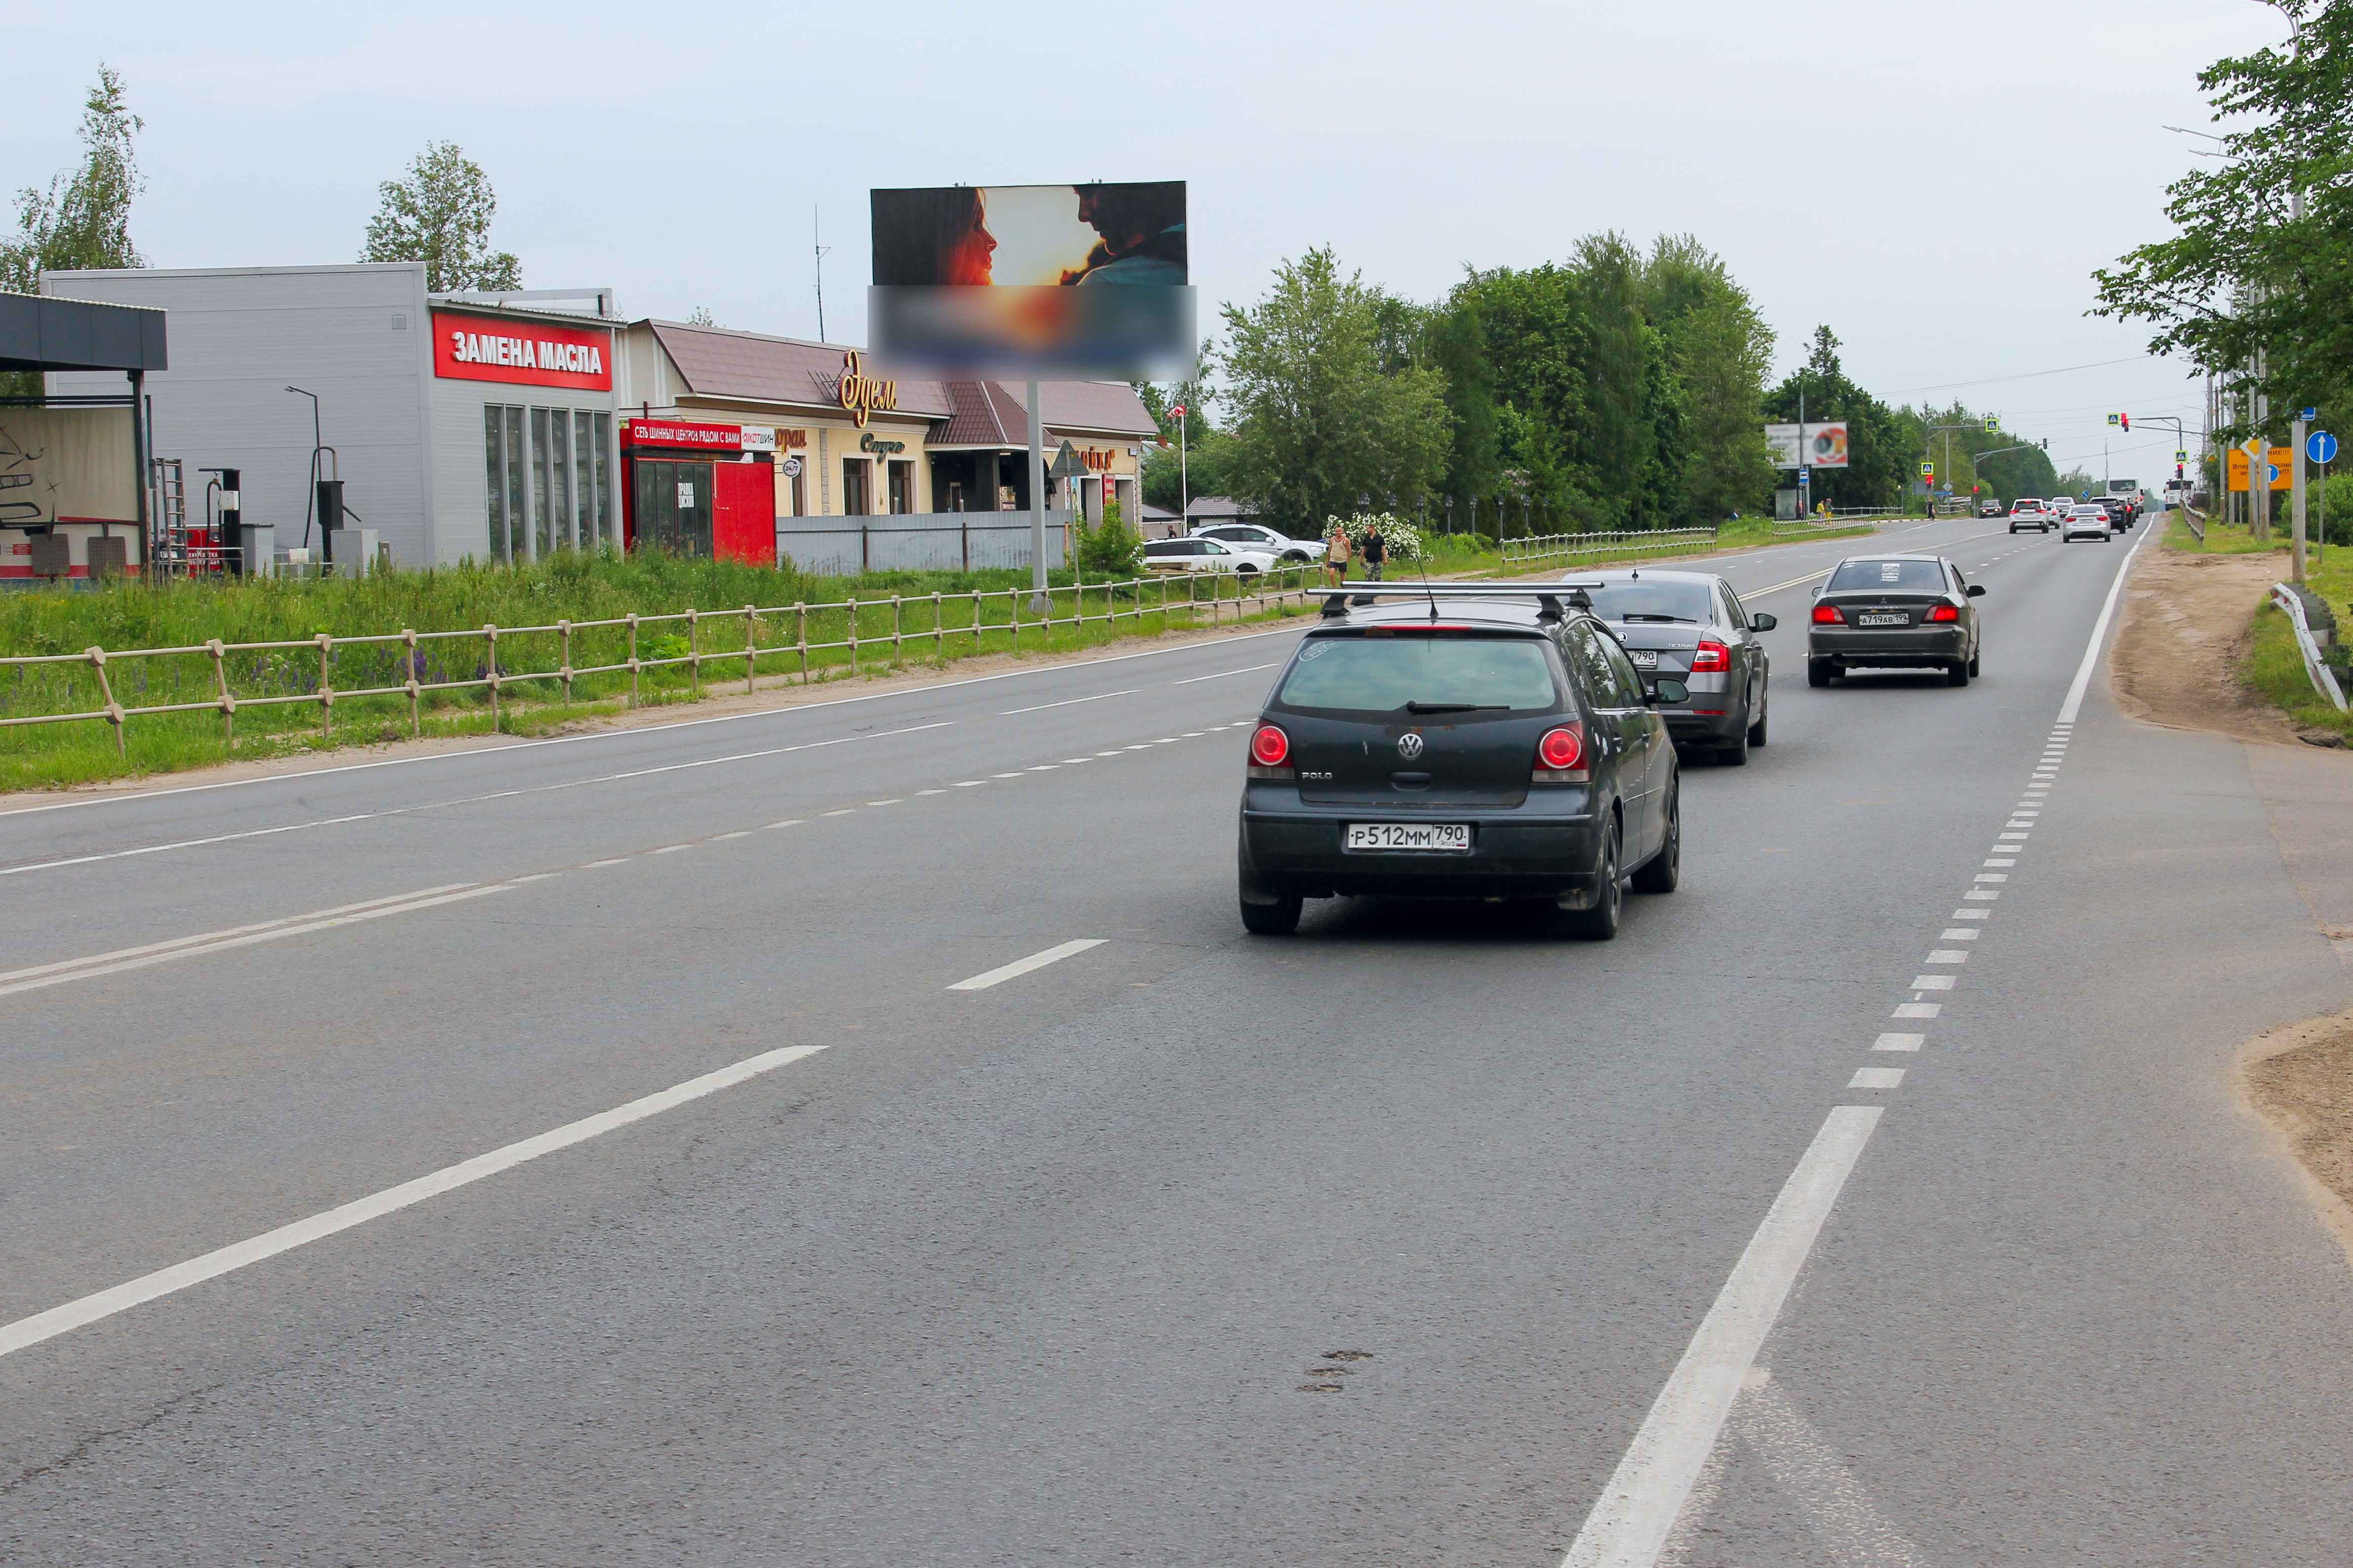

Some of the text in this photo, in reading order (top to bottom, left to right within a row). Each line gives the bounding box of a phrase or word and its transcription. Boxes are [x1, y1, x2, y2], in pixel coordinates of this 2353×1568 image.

[451, 331, 603, 374] ЗАМЕНА МАСЛА
[838, 349, 898, 429] Эдем
[635, 426, 648, 438] СЕТЬ
[649, 427, 675, 440] ШИННЫХ
[699, 430, 719, 443] РЯДОМ
[720, 432, 725, 443] С
[725, 432, 740, 444] ВАМИ
[1862, 615, 1893, 624] А719АВ
[1636, 652, 1655, 660] 790
[1355, 826, 1464, 845] Р512ММ 790
